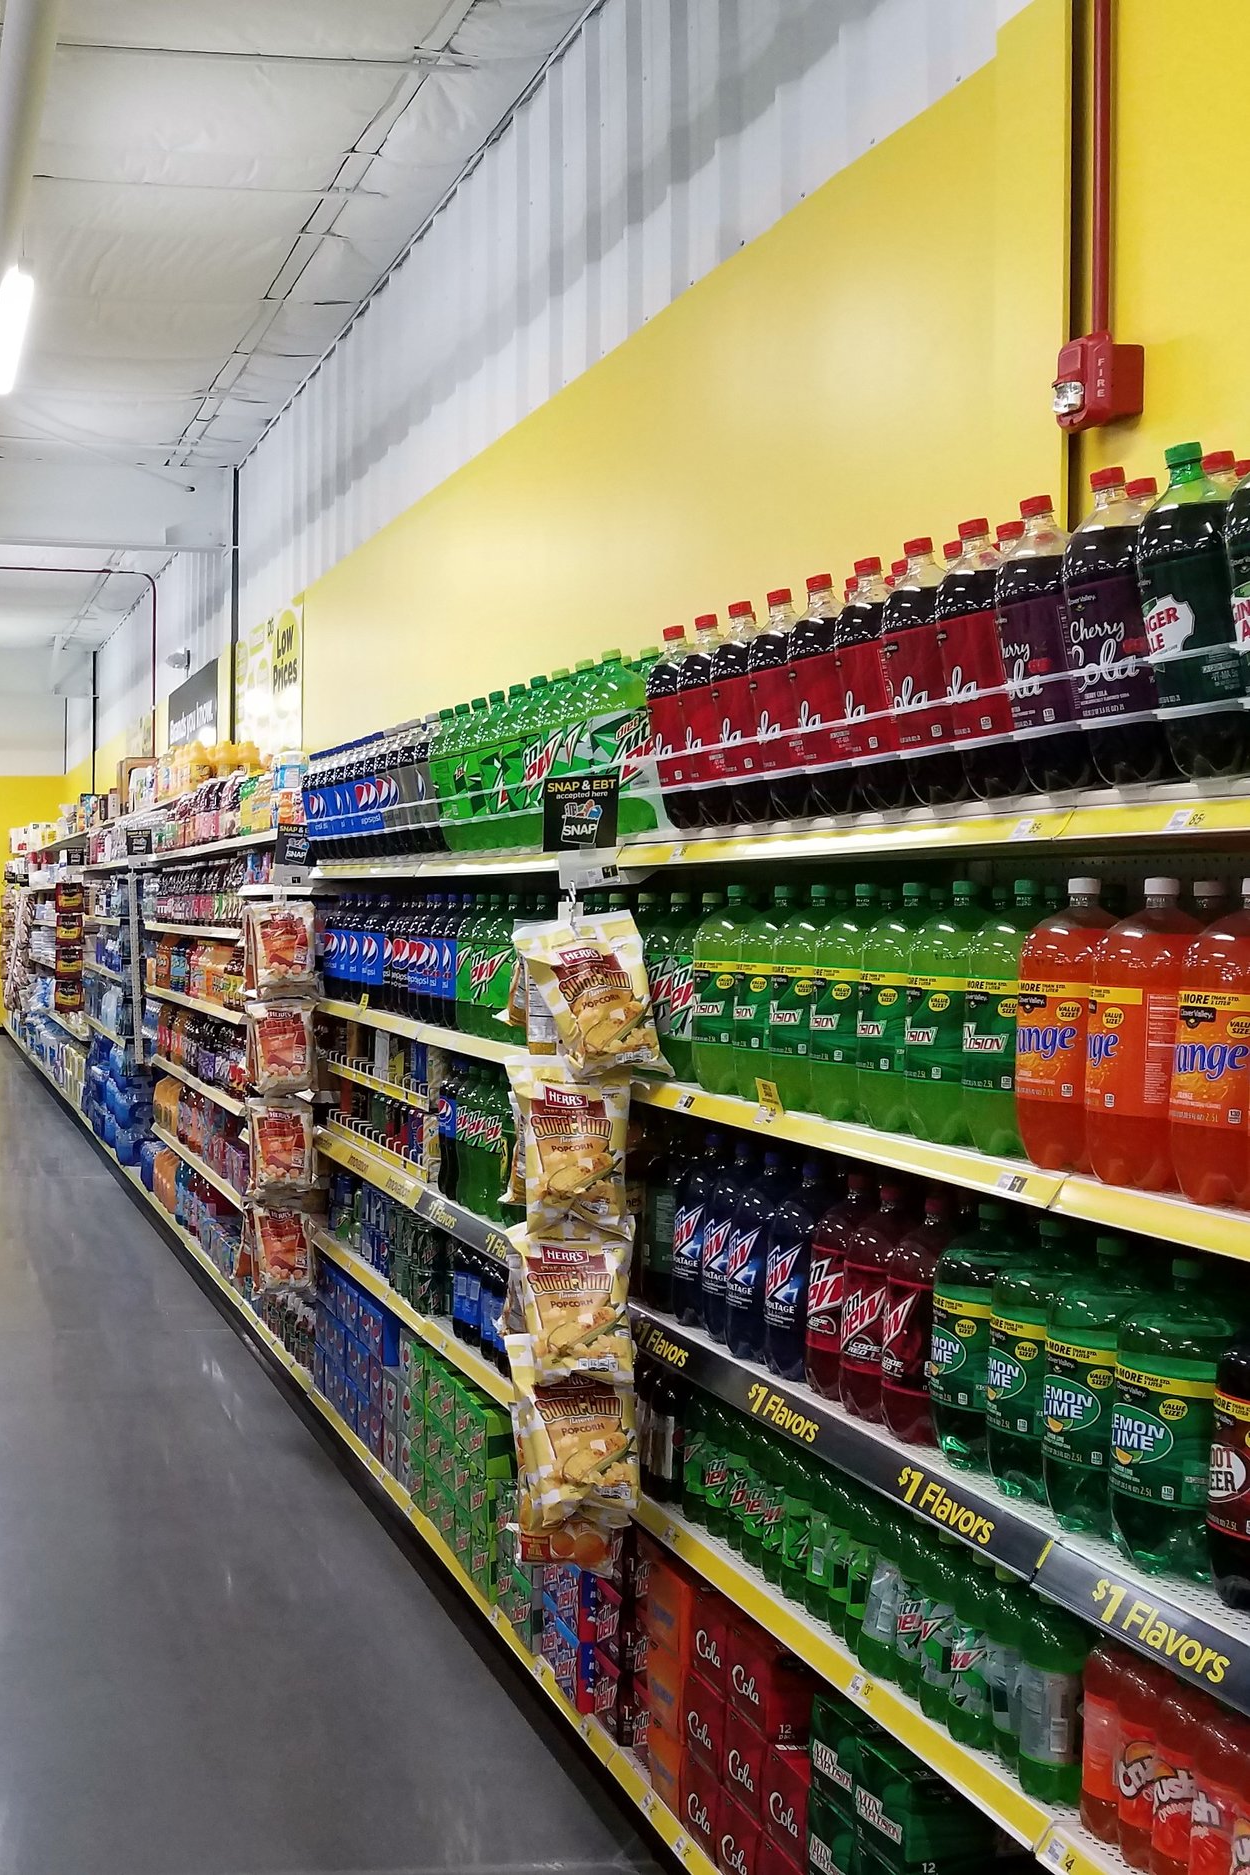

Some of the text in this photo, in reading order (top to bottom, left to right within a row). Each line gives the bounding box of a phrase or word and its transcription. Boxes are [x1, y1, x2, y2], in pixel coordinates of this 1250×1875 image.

[1096, 357, 1106, 398] FIRE
[1070, 617, 1125, 643] Cherry
[1071, 638, 1140, 694] Cola
[272, 657, 298, 695] Prices
[616, 717, 639, 739] diet
[547, 779, 617, 794] SNAP & EBT
[556, 790, 608, 800] accepted here
[562, 823, 598, 836] SNAP
[285, 851, 307, 859] SNAP
[582, 994, 621, 1010] POPCORN
[1182, 993, 1210, 1005] MORE
[548, 1091, 584, 1106] HERR'S
[551, 1142, 594, 1153] POPCORN
[436, 1205, 458, 1230] Flavors
[546, 1249, 585, 1262] HERR'S
[550, 1299, 594, 1309] POPCORN
[649, 1330, 690, 1368] Flavors
[852, 1341, 882, 1353] CODE
[931, 1336, 960, 1354] MON
[1017, 1345, 1037, 1353] VALUE
[1050, 1341, 1071, 1356] MORE
[1090, 1373, 1112, 1381] VALUE
[1118, 1367, 1143, 1384] MORE
[1144, 1375, 1159, 1383] THAN
[747, 1383, 820, 1443] $1 Flavors
[1162, 1403, 1186, 1412] VALUE
[561, 1422, 606, 1437] POPCORN
[1112, 1427, 1155, 1452] LIME
[1140, 1487, 1152, 1497] 2.5L
[897, 1466, 997, 1545] $1 Flavors
[1093, 1578, 1232, 1685] $1 Flavors
[696, 1629, 721, 1669] Cola
[731, 1664, 760, 1705] Cola
[687, 1711, 712, 1750] Cola
[778, 1724, 792, 1736] 12
[728, 1749, 754, 1793] Cola
[687, 1793, 711, 1835] Cola
[769, 1791, 799, 1839] Cola
[922, 1862, 937, 1874] 12
